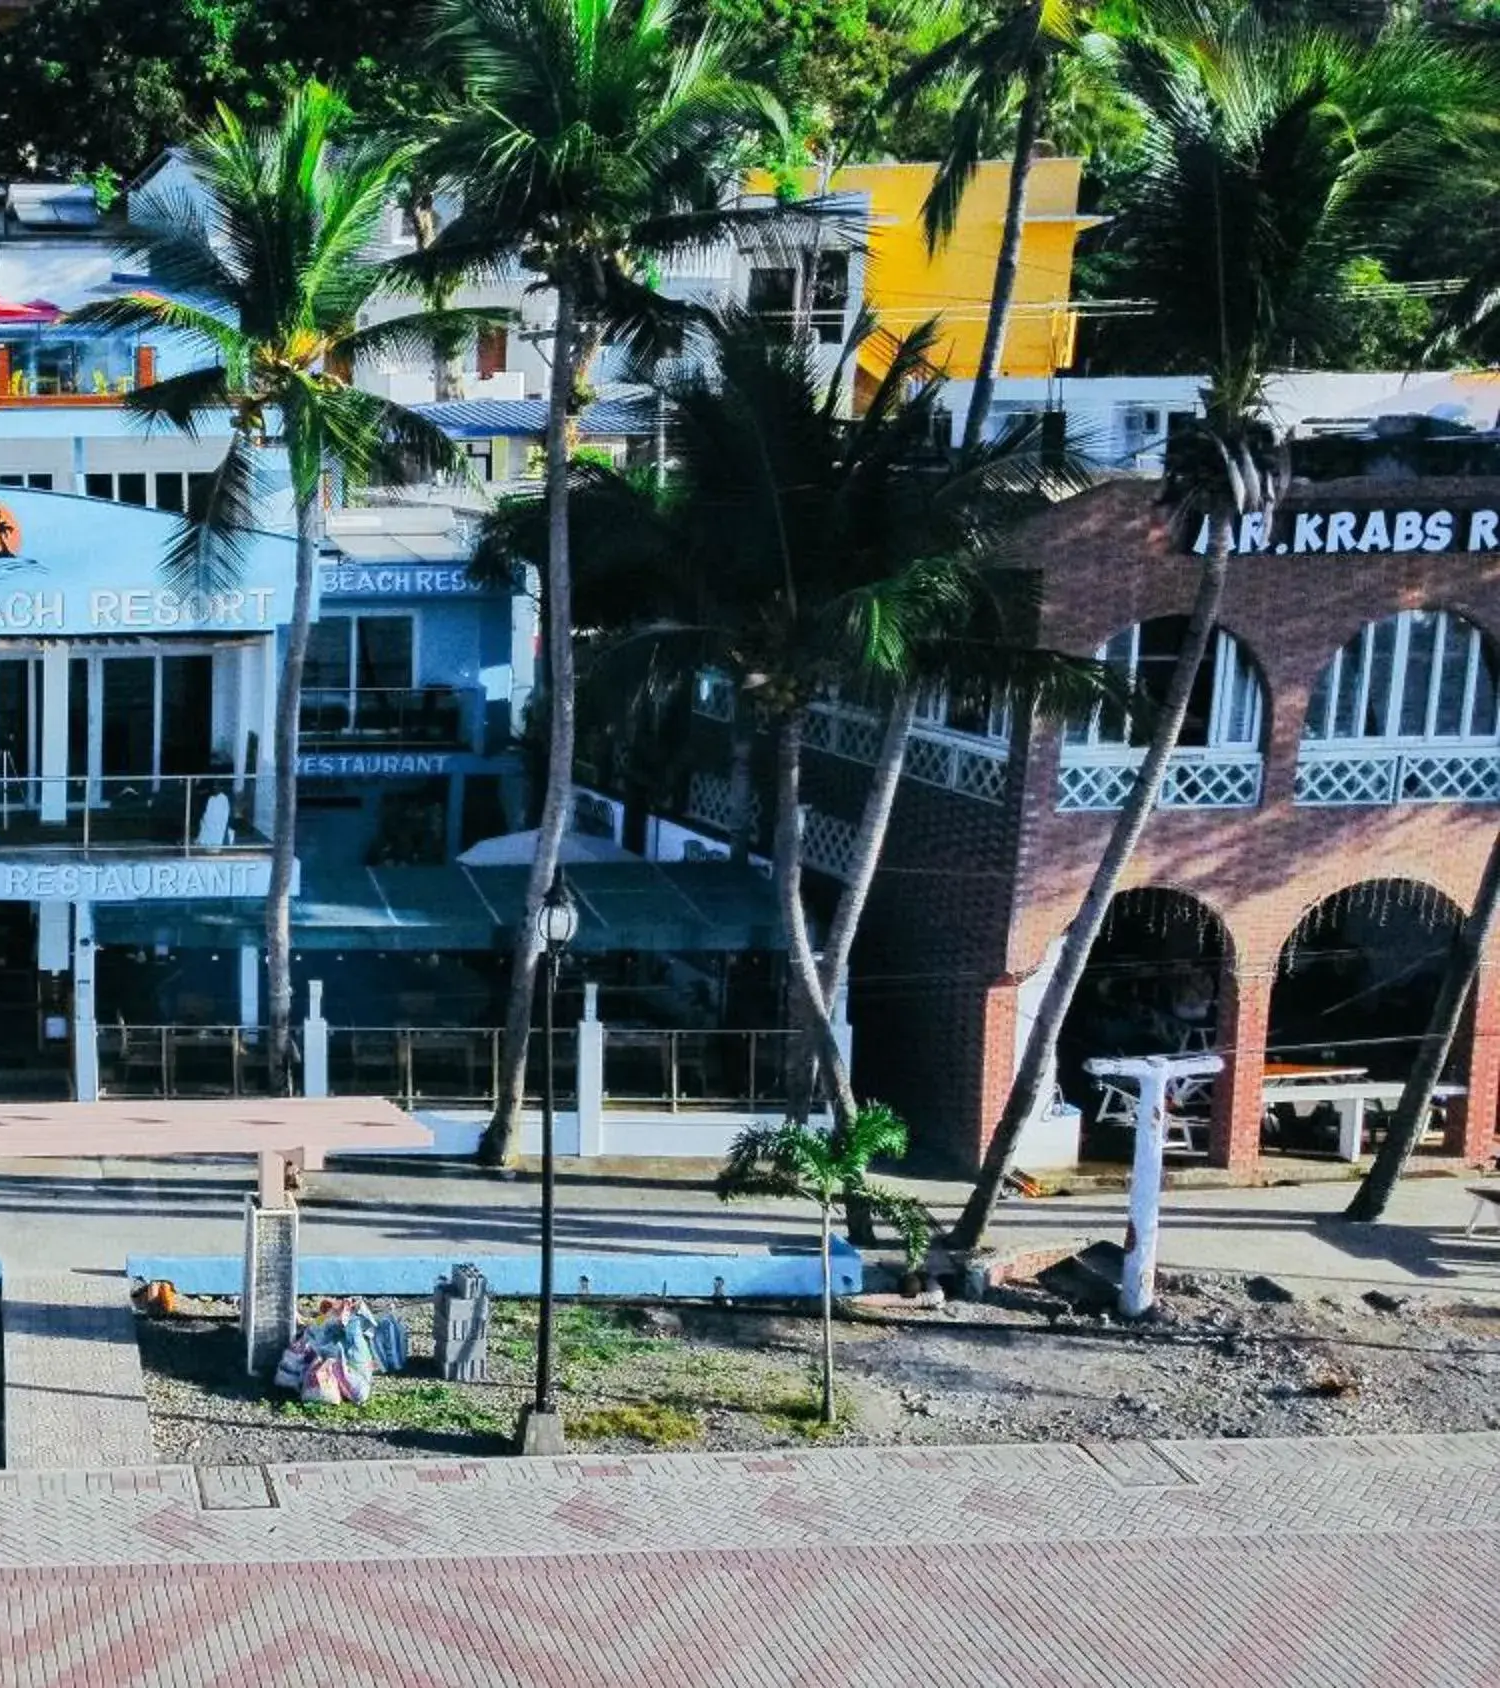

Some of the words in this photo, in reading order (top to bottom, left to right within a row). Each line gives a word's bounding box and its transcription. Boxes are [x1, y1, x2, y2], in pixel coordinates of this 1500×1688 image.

[1293, 510, 1454, 553] KRABS
[322, 570, 410, 593] BEACH
[416, 569, 485, 592] RES
[88, 586, 277, 627] RESORT
[4, 863, 258, 899] RESTAURANT
